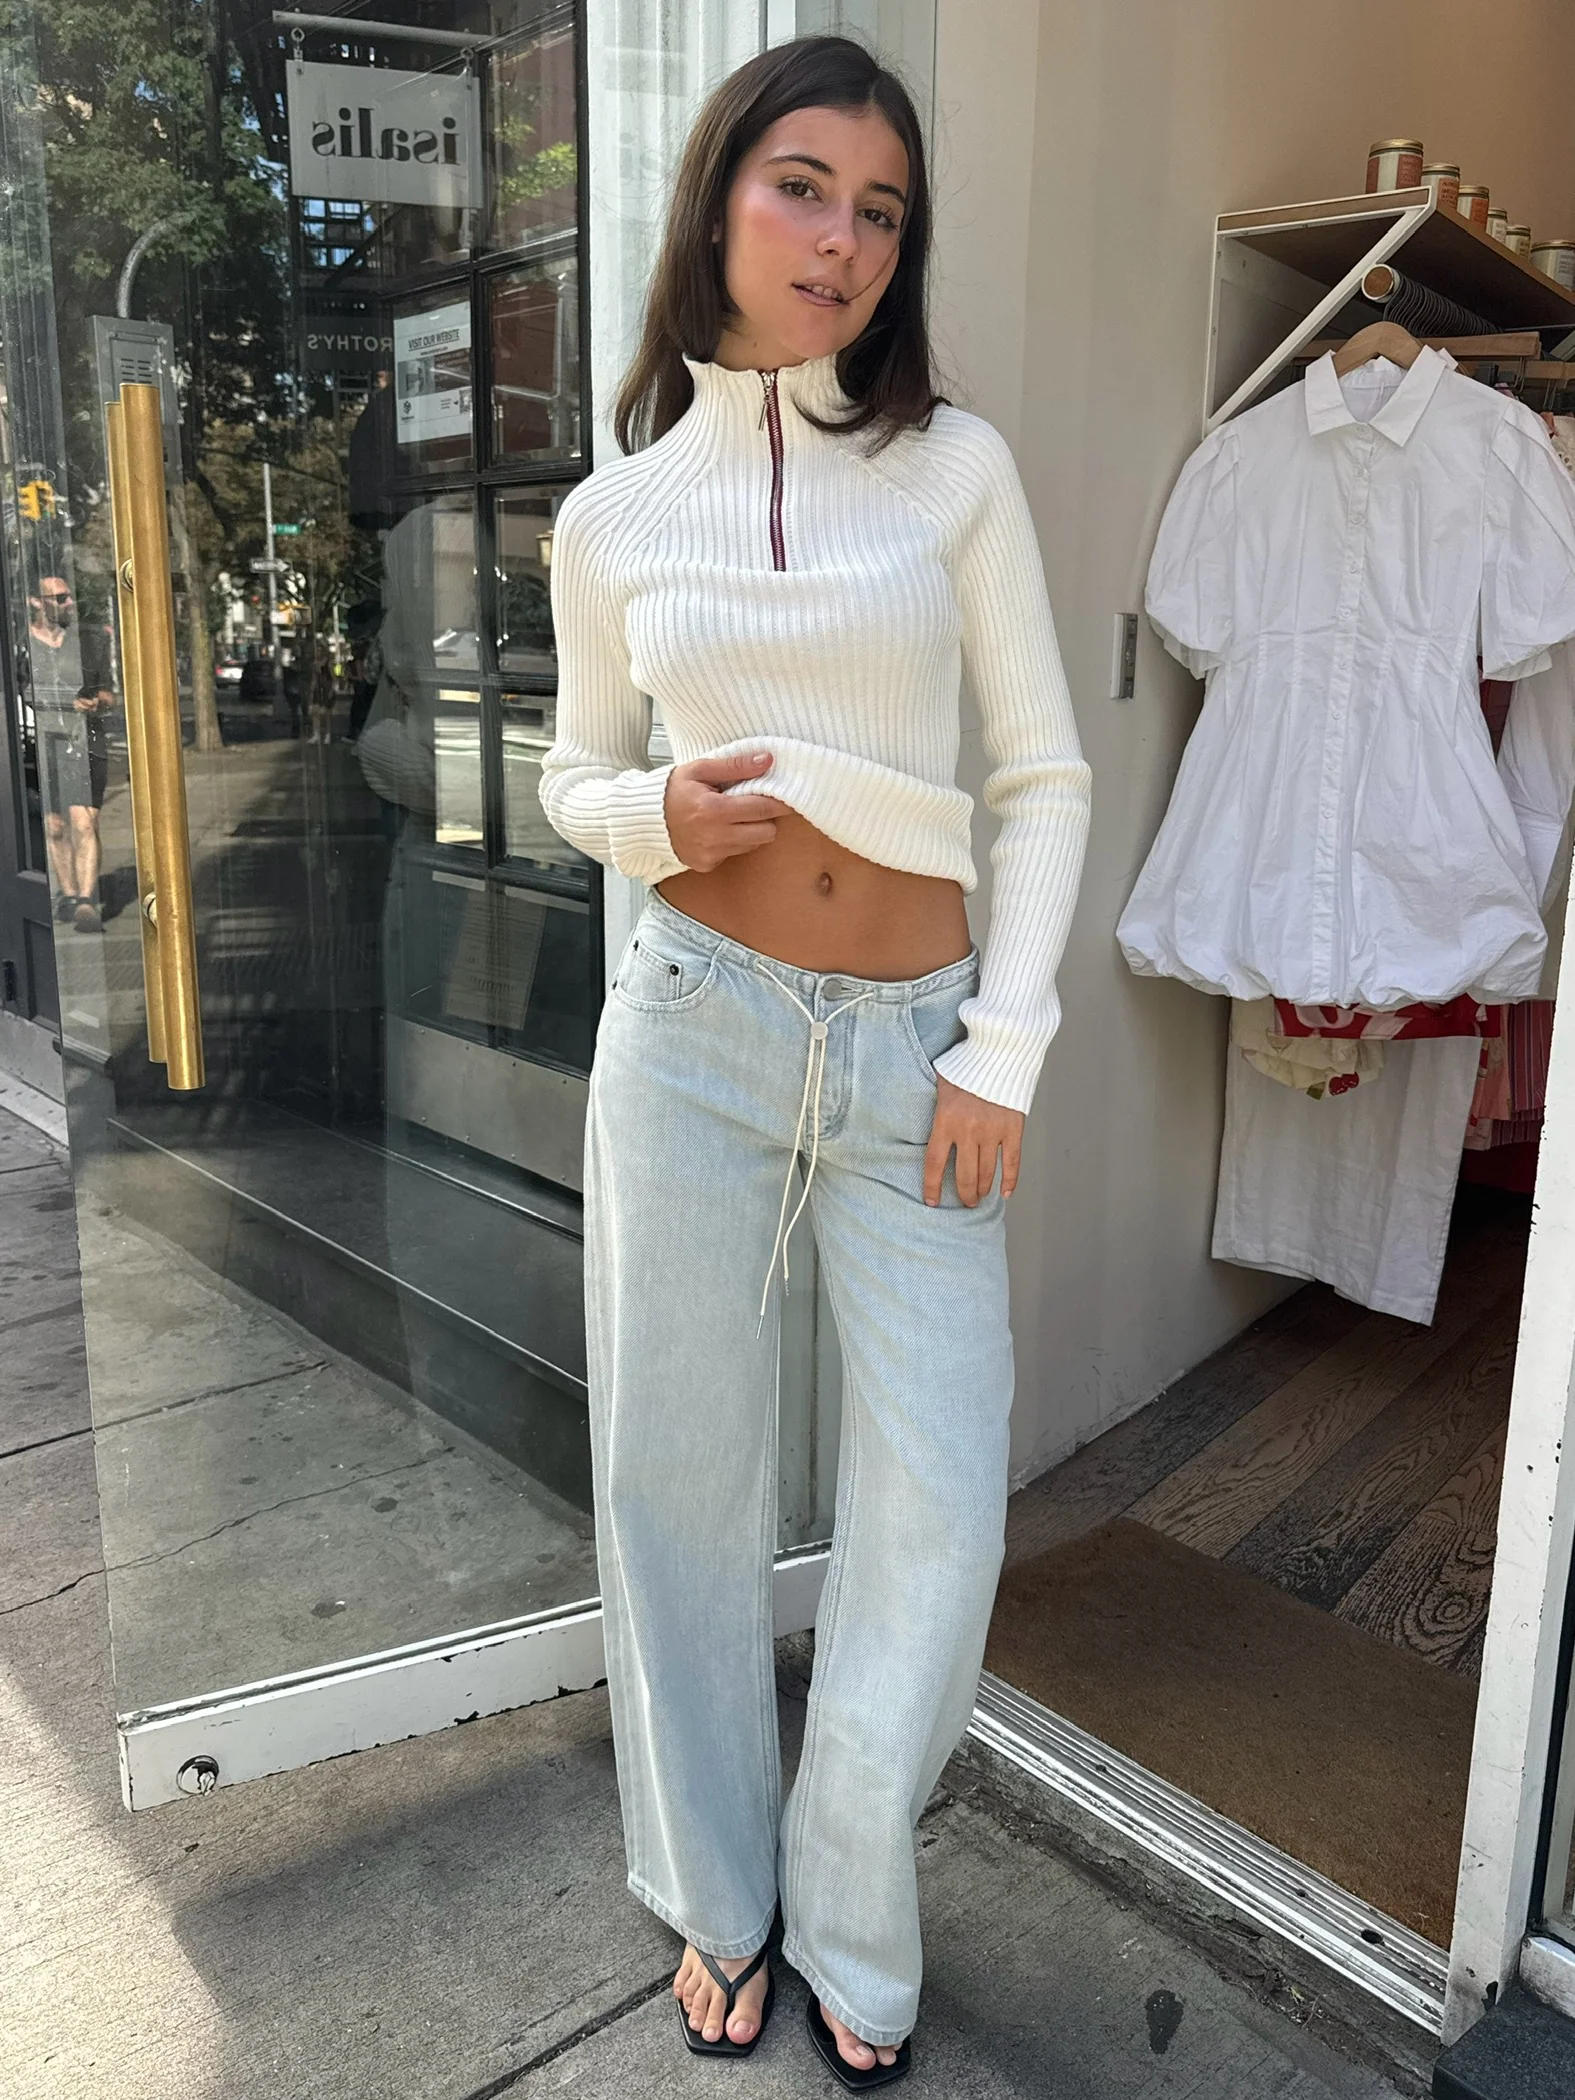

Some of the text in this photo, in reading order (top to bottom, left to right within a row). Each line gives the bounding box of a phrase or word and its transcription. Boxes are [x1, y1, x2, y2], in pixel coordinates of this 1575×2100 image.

[408, 329, 460, 350] VISIT OUR WEBSITE
